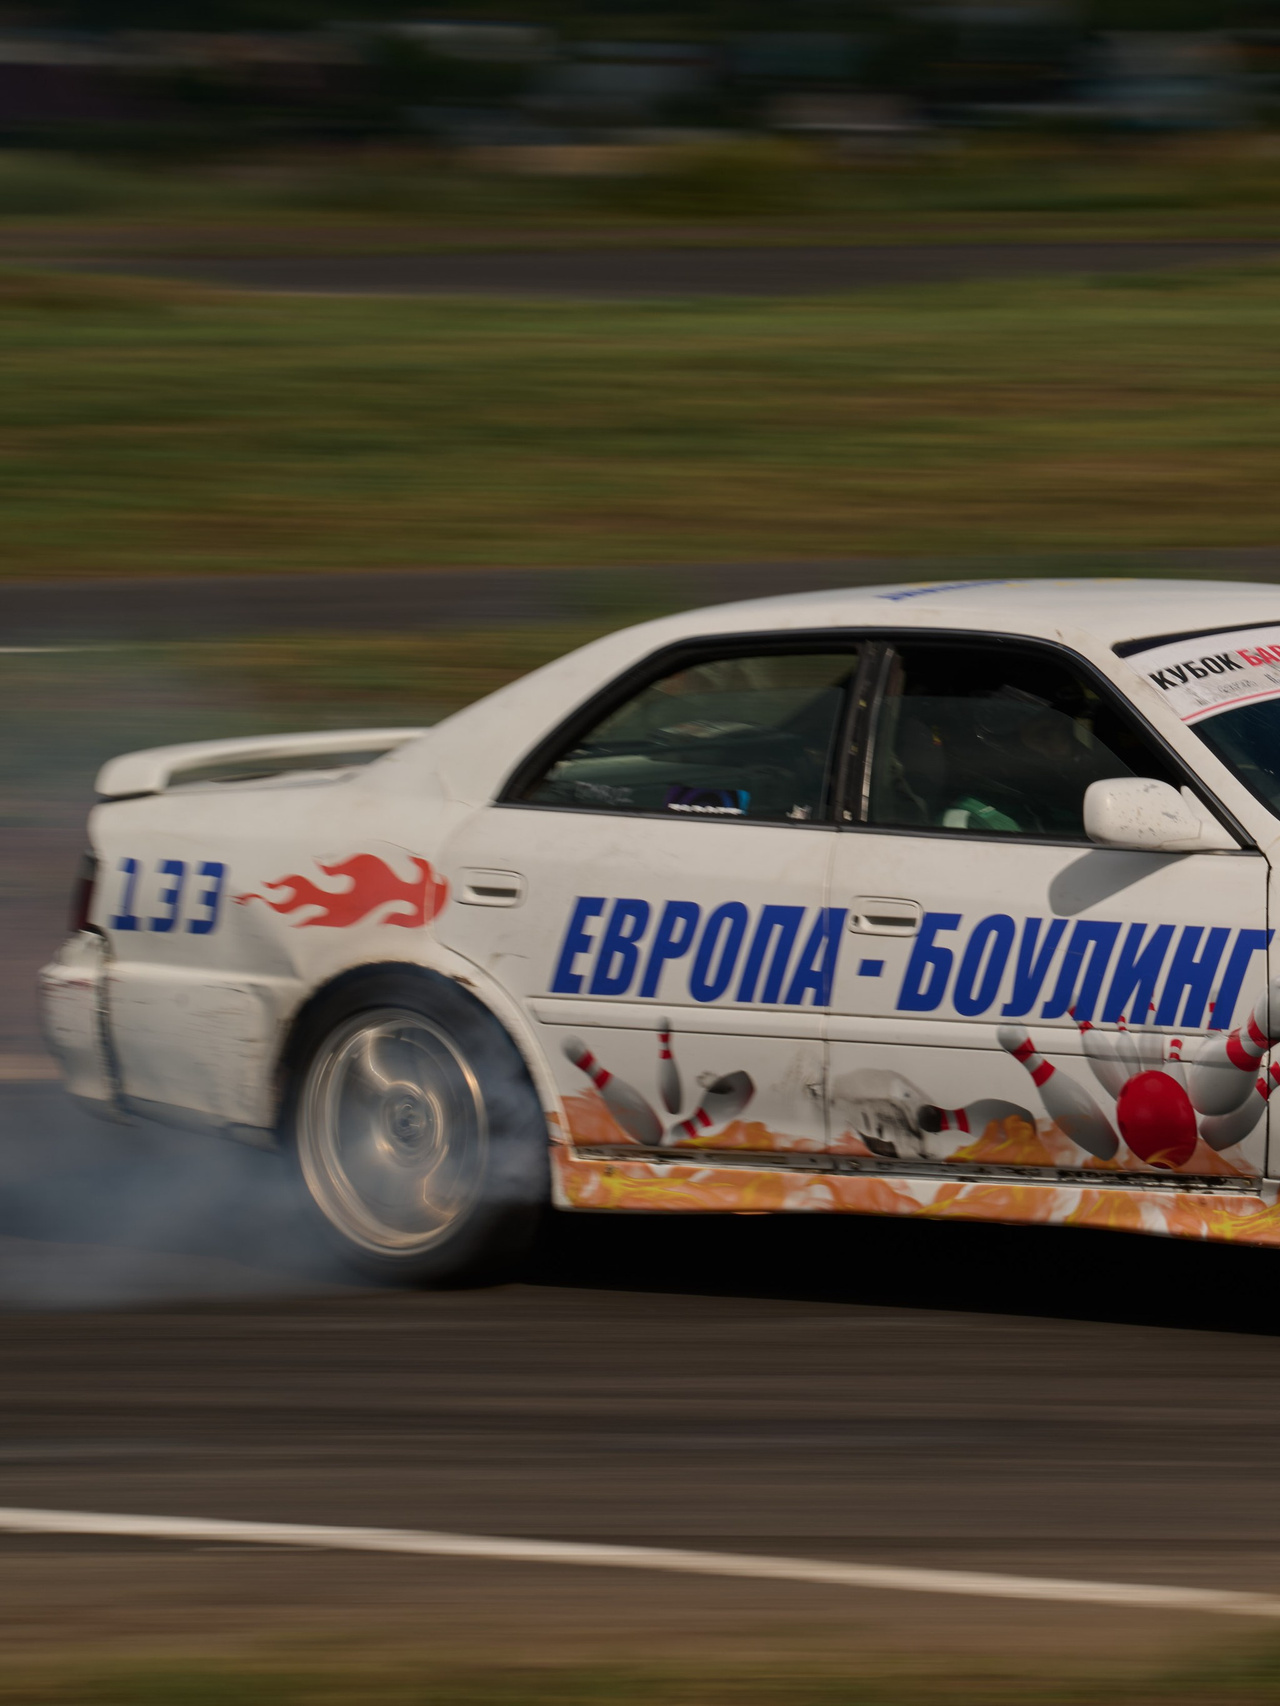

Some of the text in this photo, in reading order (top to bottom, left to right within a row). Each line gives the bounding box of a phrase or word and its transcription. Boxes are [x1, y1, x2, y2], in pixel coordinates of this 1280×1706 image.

[1148, 651, 1244, 691] КУБОК
[111, 858, 226, 935] 133
[550, 896, 849, 1007] ЕВРОПА
[896, 912, 1276, 1030] БОУЛИНГ
